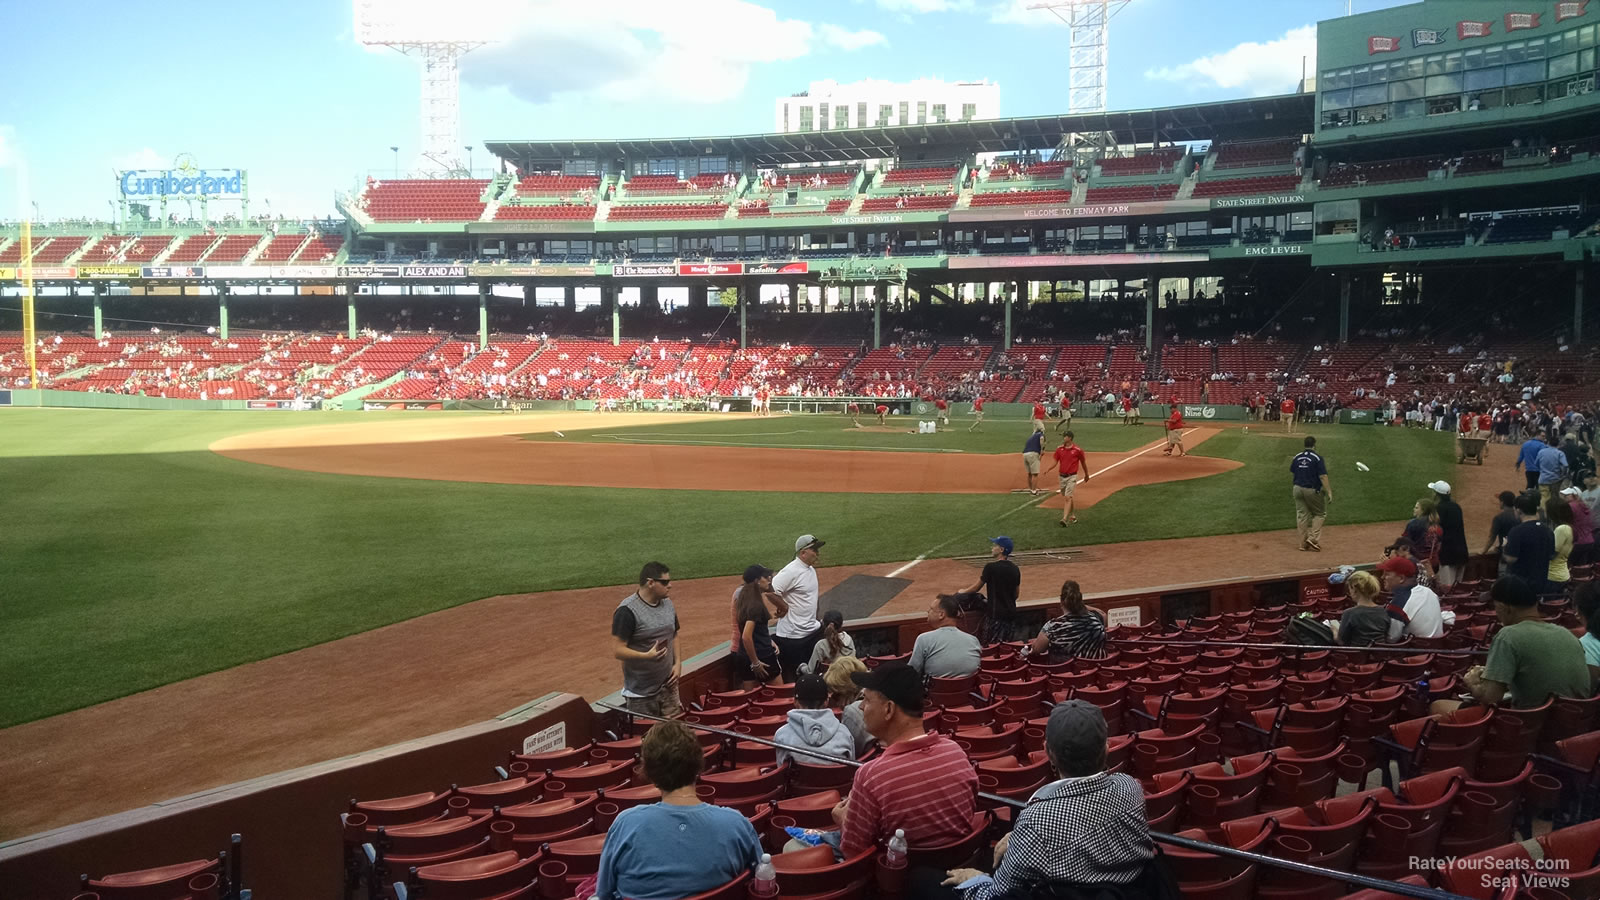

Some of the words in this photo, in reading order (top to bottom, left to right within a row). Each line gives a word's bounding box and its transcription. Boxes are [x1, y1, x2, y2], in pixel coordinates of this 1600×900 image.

[121, 169, 240, 195] Cumberland
[1217, 199, 1239, 207] STATE
[1240, 197, 1266, 206] STREET
[1268, 195, 1304, 204] PAVILION
[1024, 208, 1059, 217] WELCOME
[1062, 208, 1071, 216] TO
[1073, 206, 1106, 215] FENWAY
[1108, 205, 1129, 214] PARK
[831, 216, 849, 224] STATE
[873, 215, 903, 223] PAVILION
[1245, 247, 1268, 255] EMC
[1271, 246, 1304, 254] LEVEL
[405, 267, 426, 276] ALEX
[428, 267, 448, 276] AND
[449, 267, 465, 276] ANI
